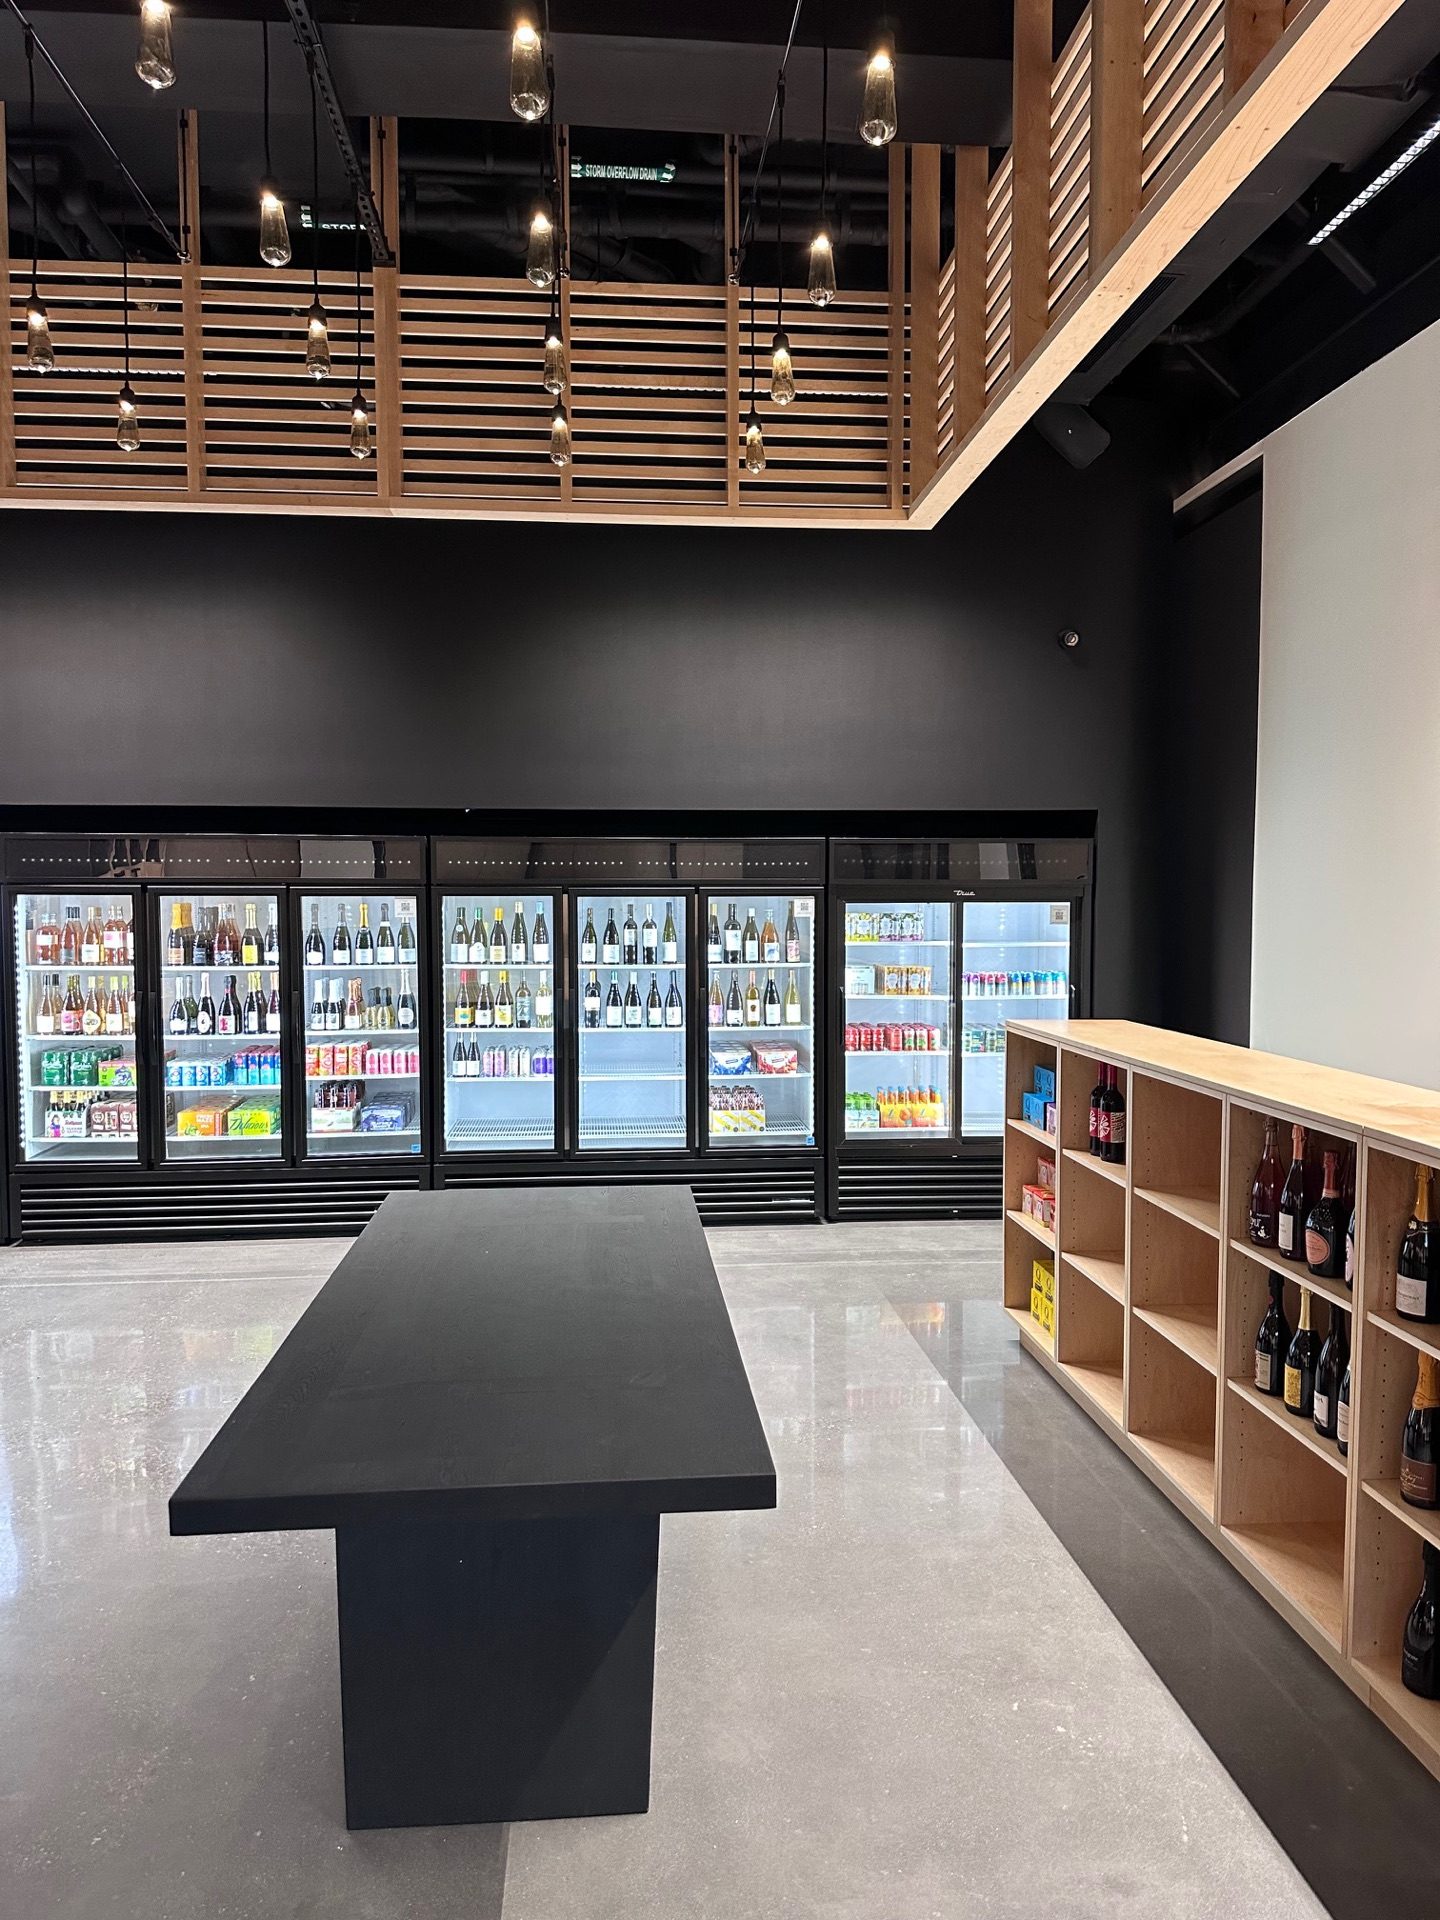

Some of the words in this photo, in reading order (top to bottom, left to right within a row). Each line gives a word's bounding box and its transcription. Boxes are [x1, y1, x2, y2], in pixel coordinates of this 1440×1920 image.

[585, 164, 606, 178] STORM
[607, 165, 639, 179] OVERFLOW
[640, 167, 658, 181] DRAIN
